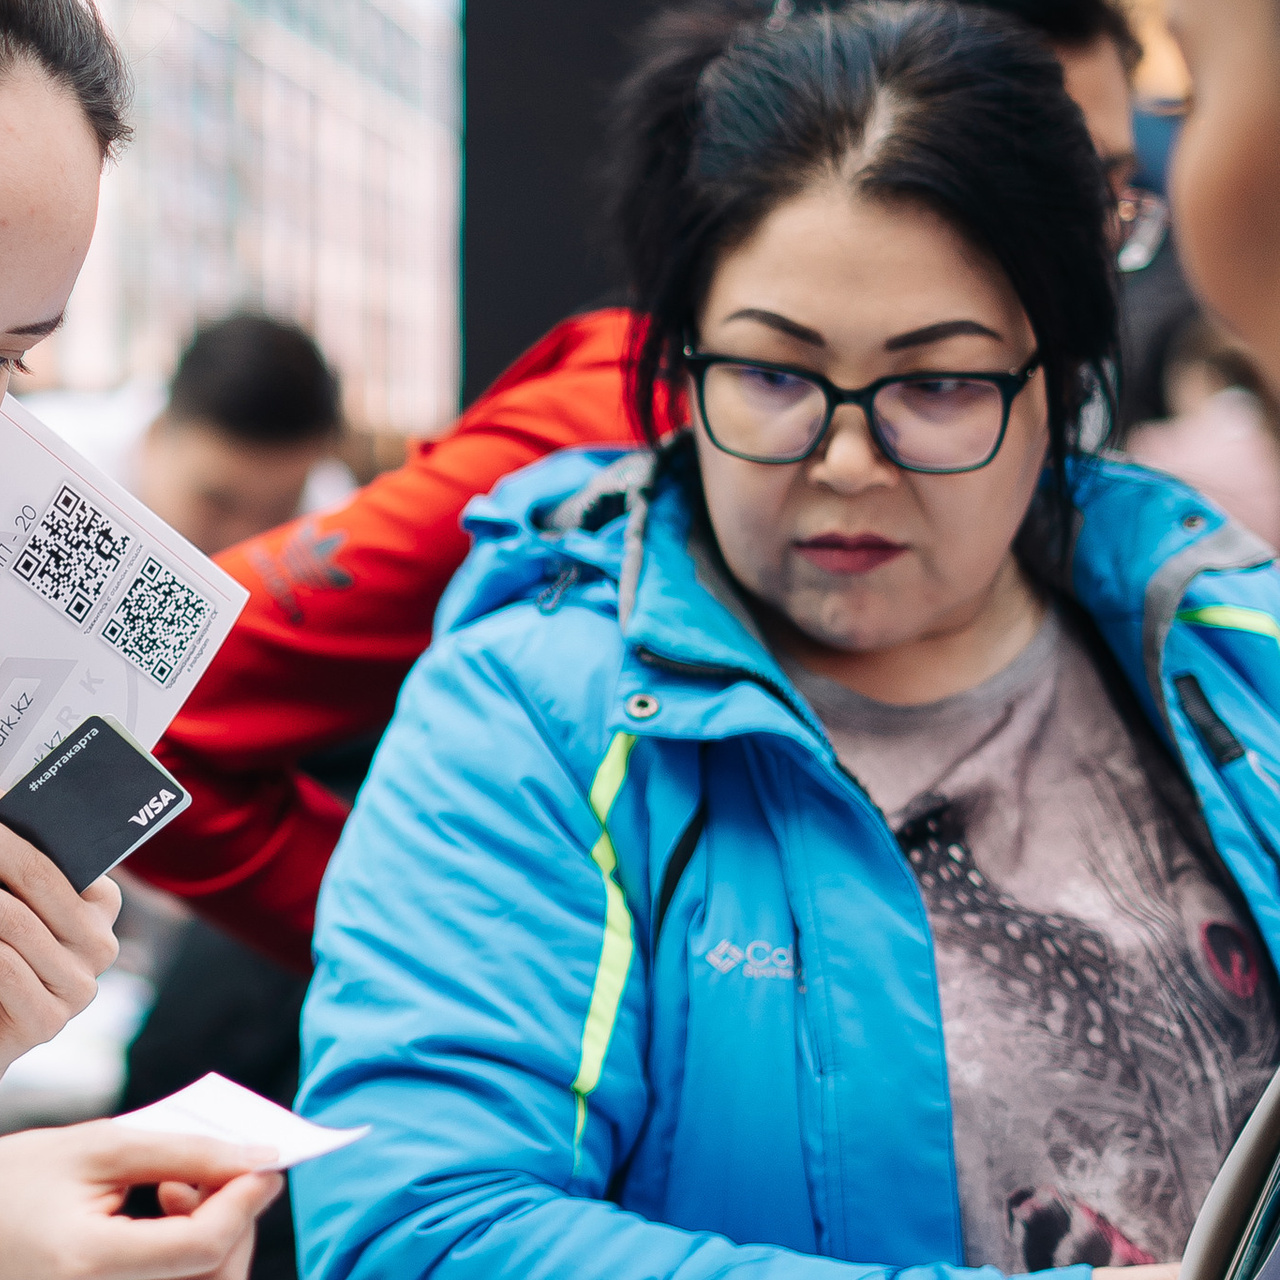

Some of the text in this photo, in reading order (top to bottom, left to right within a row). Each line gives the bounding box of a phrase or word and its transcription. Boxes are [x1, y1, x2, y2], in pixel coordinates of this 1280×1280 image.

[14, 504, 36, 532] 20
[28, 727, 100, 792] #картакарта
[127, 788, 177, 827] VISA
